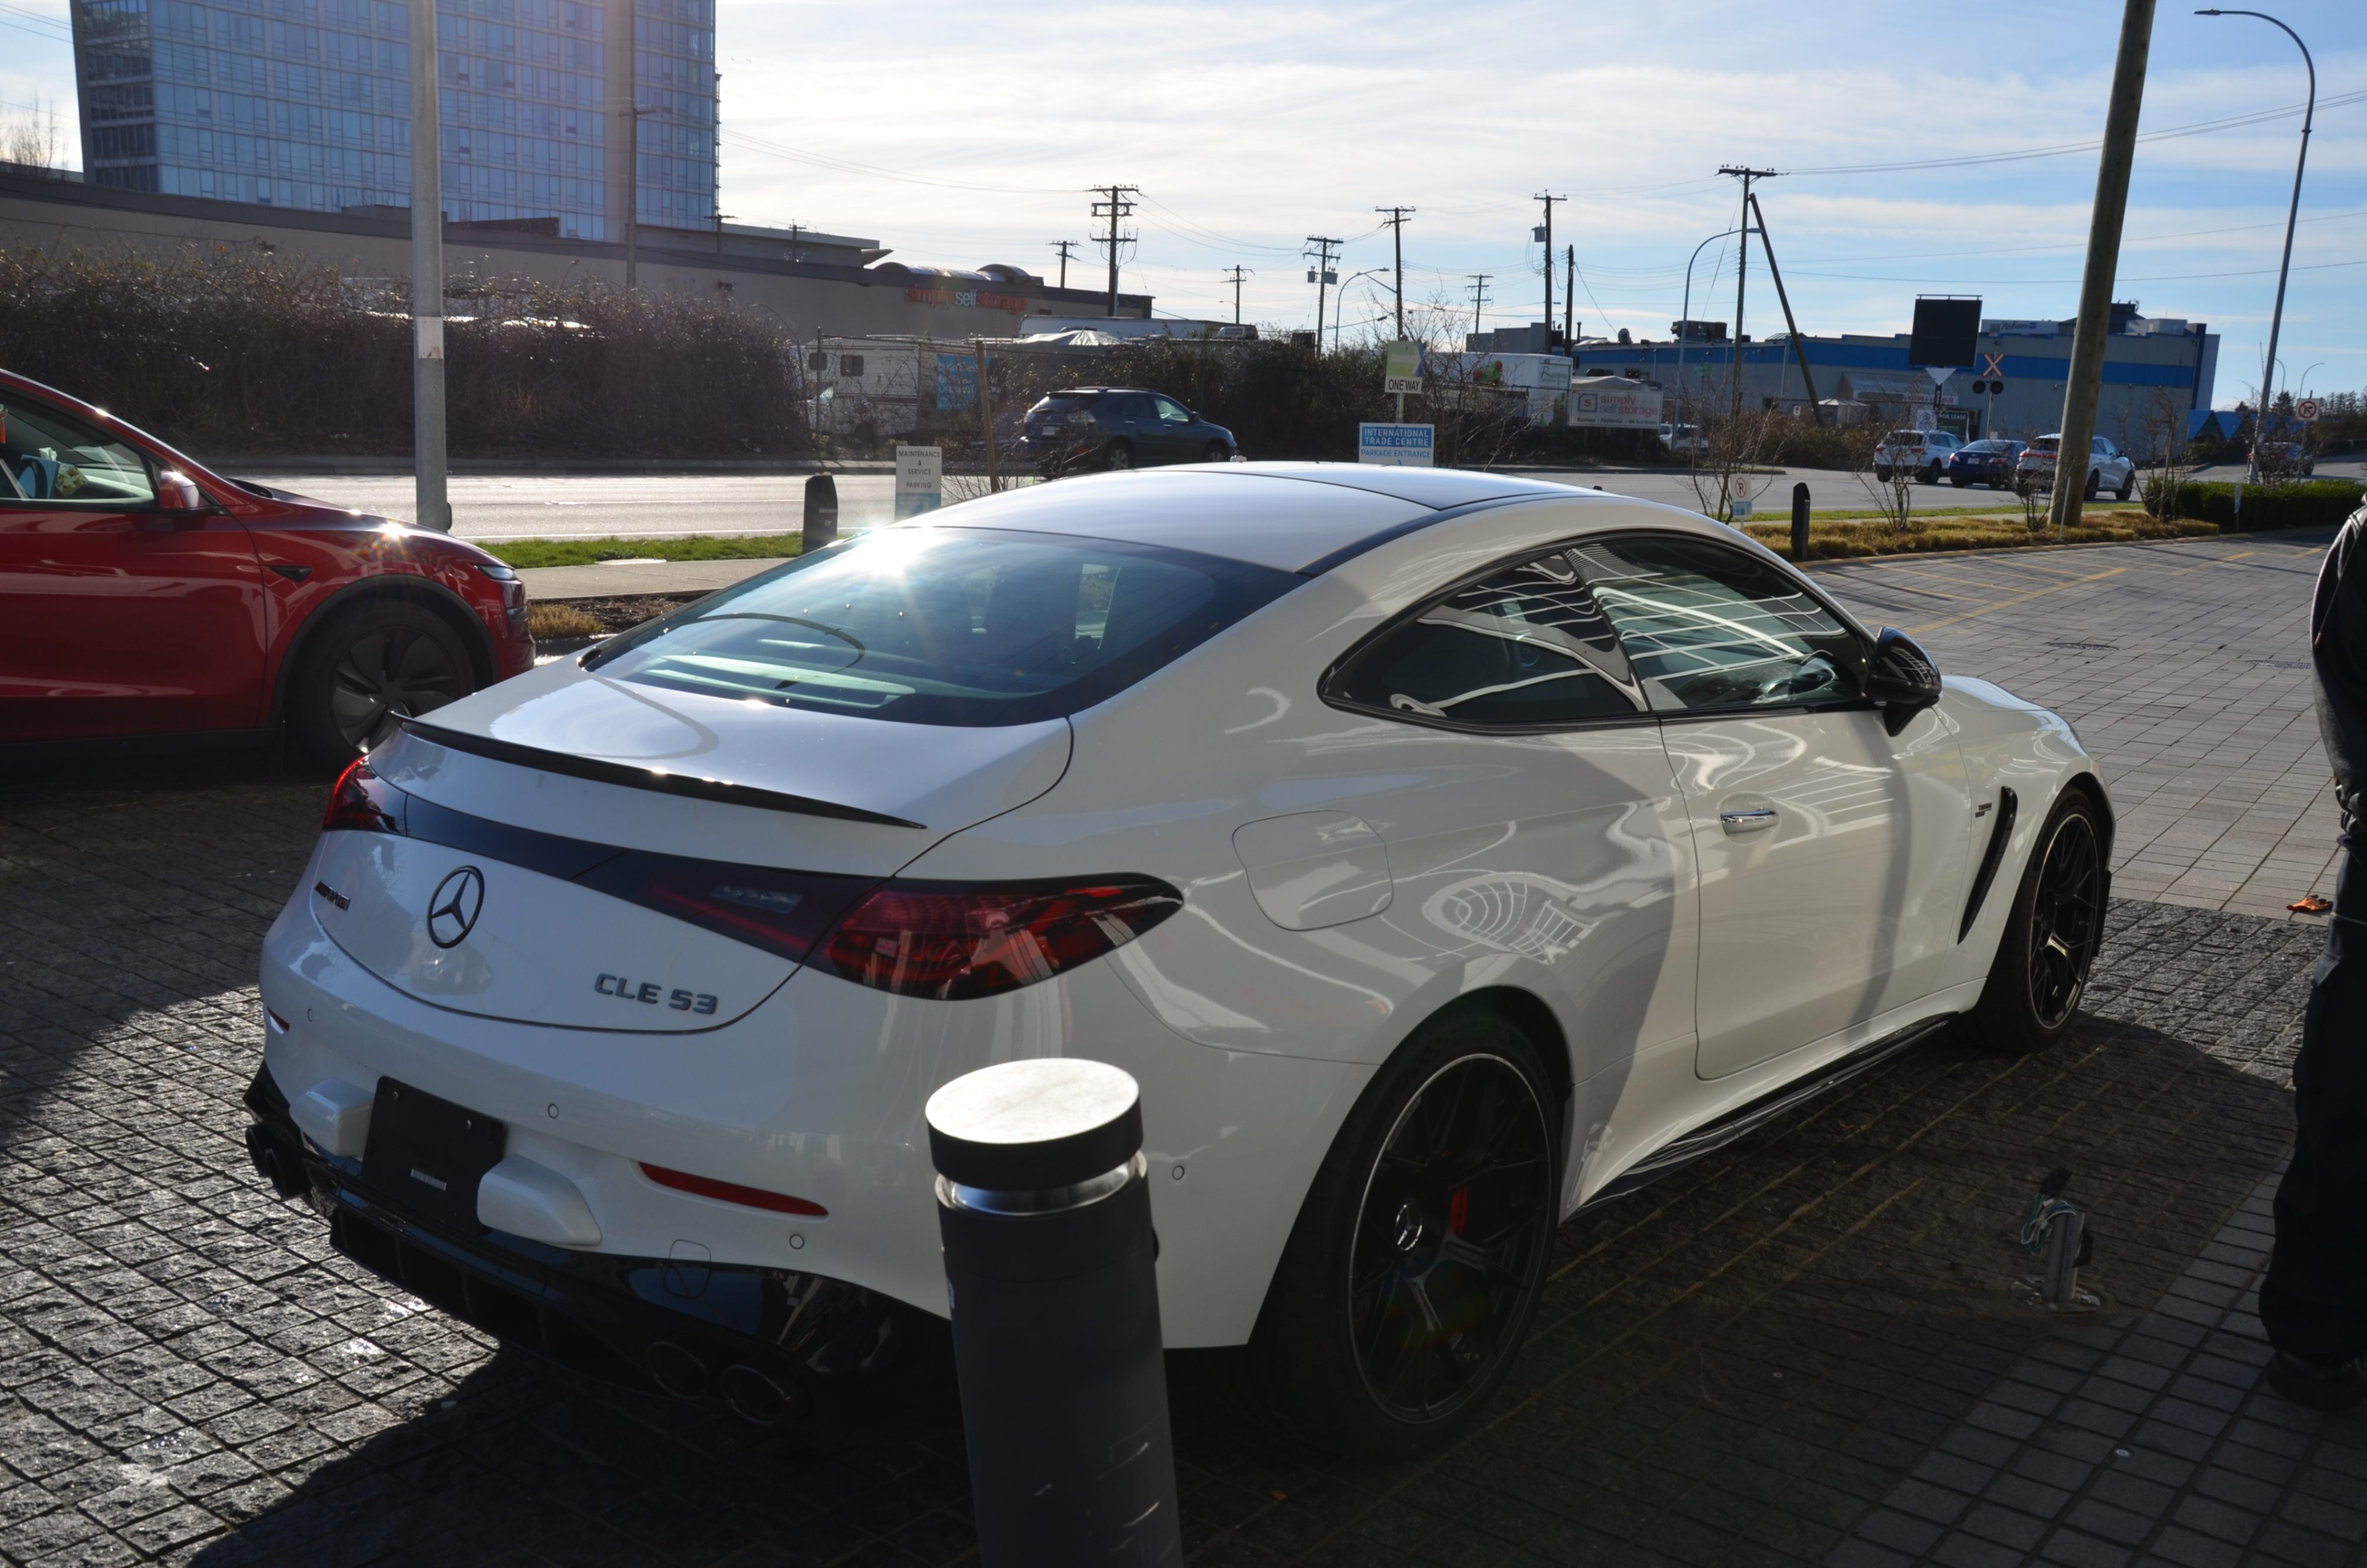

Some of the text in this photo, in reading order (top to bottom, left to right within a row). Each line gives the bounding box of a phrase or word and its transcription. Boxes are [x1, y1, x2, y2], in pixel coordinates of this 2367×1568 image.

[955, 289, 977, 306] self
[1388, 379, 1420, 391] ONE WAY
[1600, 394, 1636, 406] simply
[1600, 404, 1658, 418] self storage
[1364, 428, 1428, 438] INTERNATIONAL
[1365, 437, 1428, 446] TRADE CENTRE
[1394, 450, 1432, 458] ENTRANCE
[594, 973, 718, 1015] CLE 53
